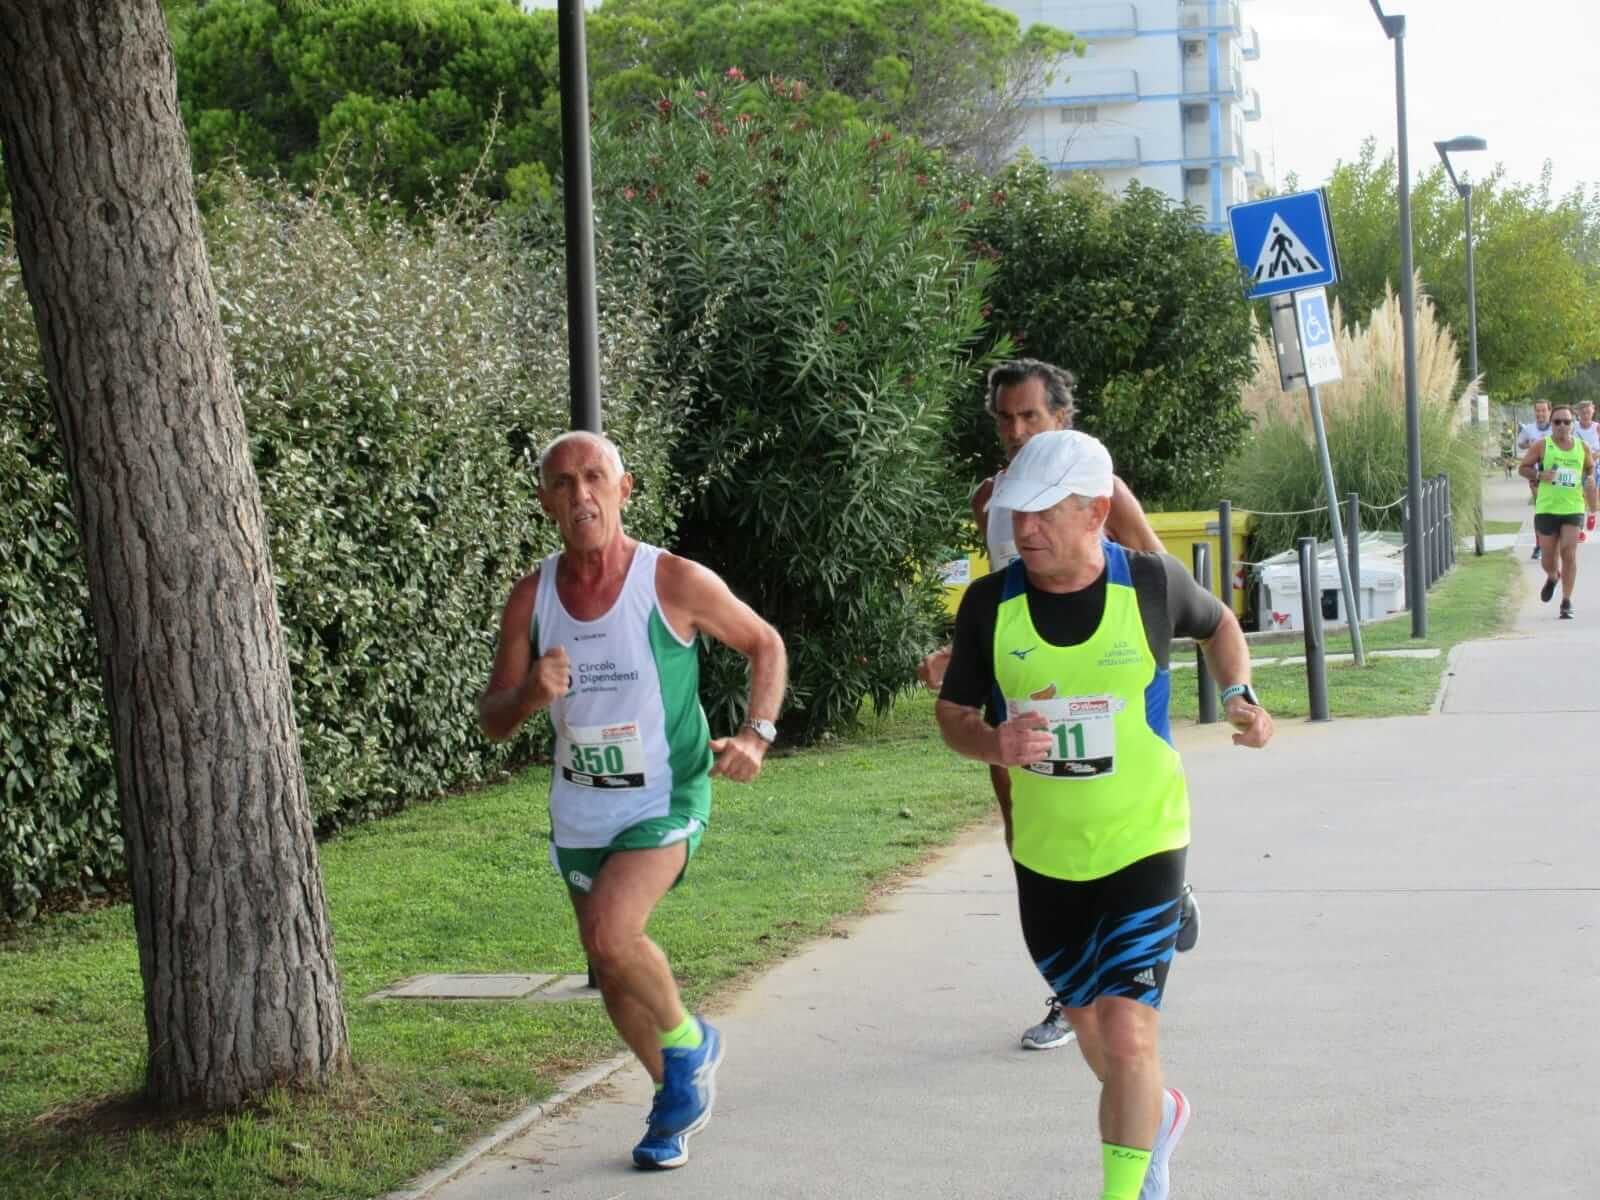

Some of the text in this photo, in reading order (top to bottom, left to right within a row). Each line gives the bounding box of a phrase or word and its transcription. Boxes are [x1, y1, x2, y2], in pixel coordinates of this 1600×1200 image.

[578, 660, 616, 673] Circolo
[579, 671, 639, 684] Dipendenti
[1036, 722, 1085, 758] 11
[570, 744, 624, 774] 350
